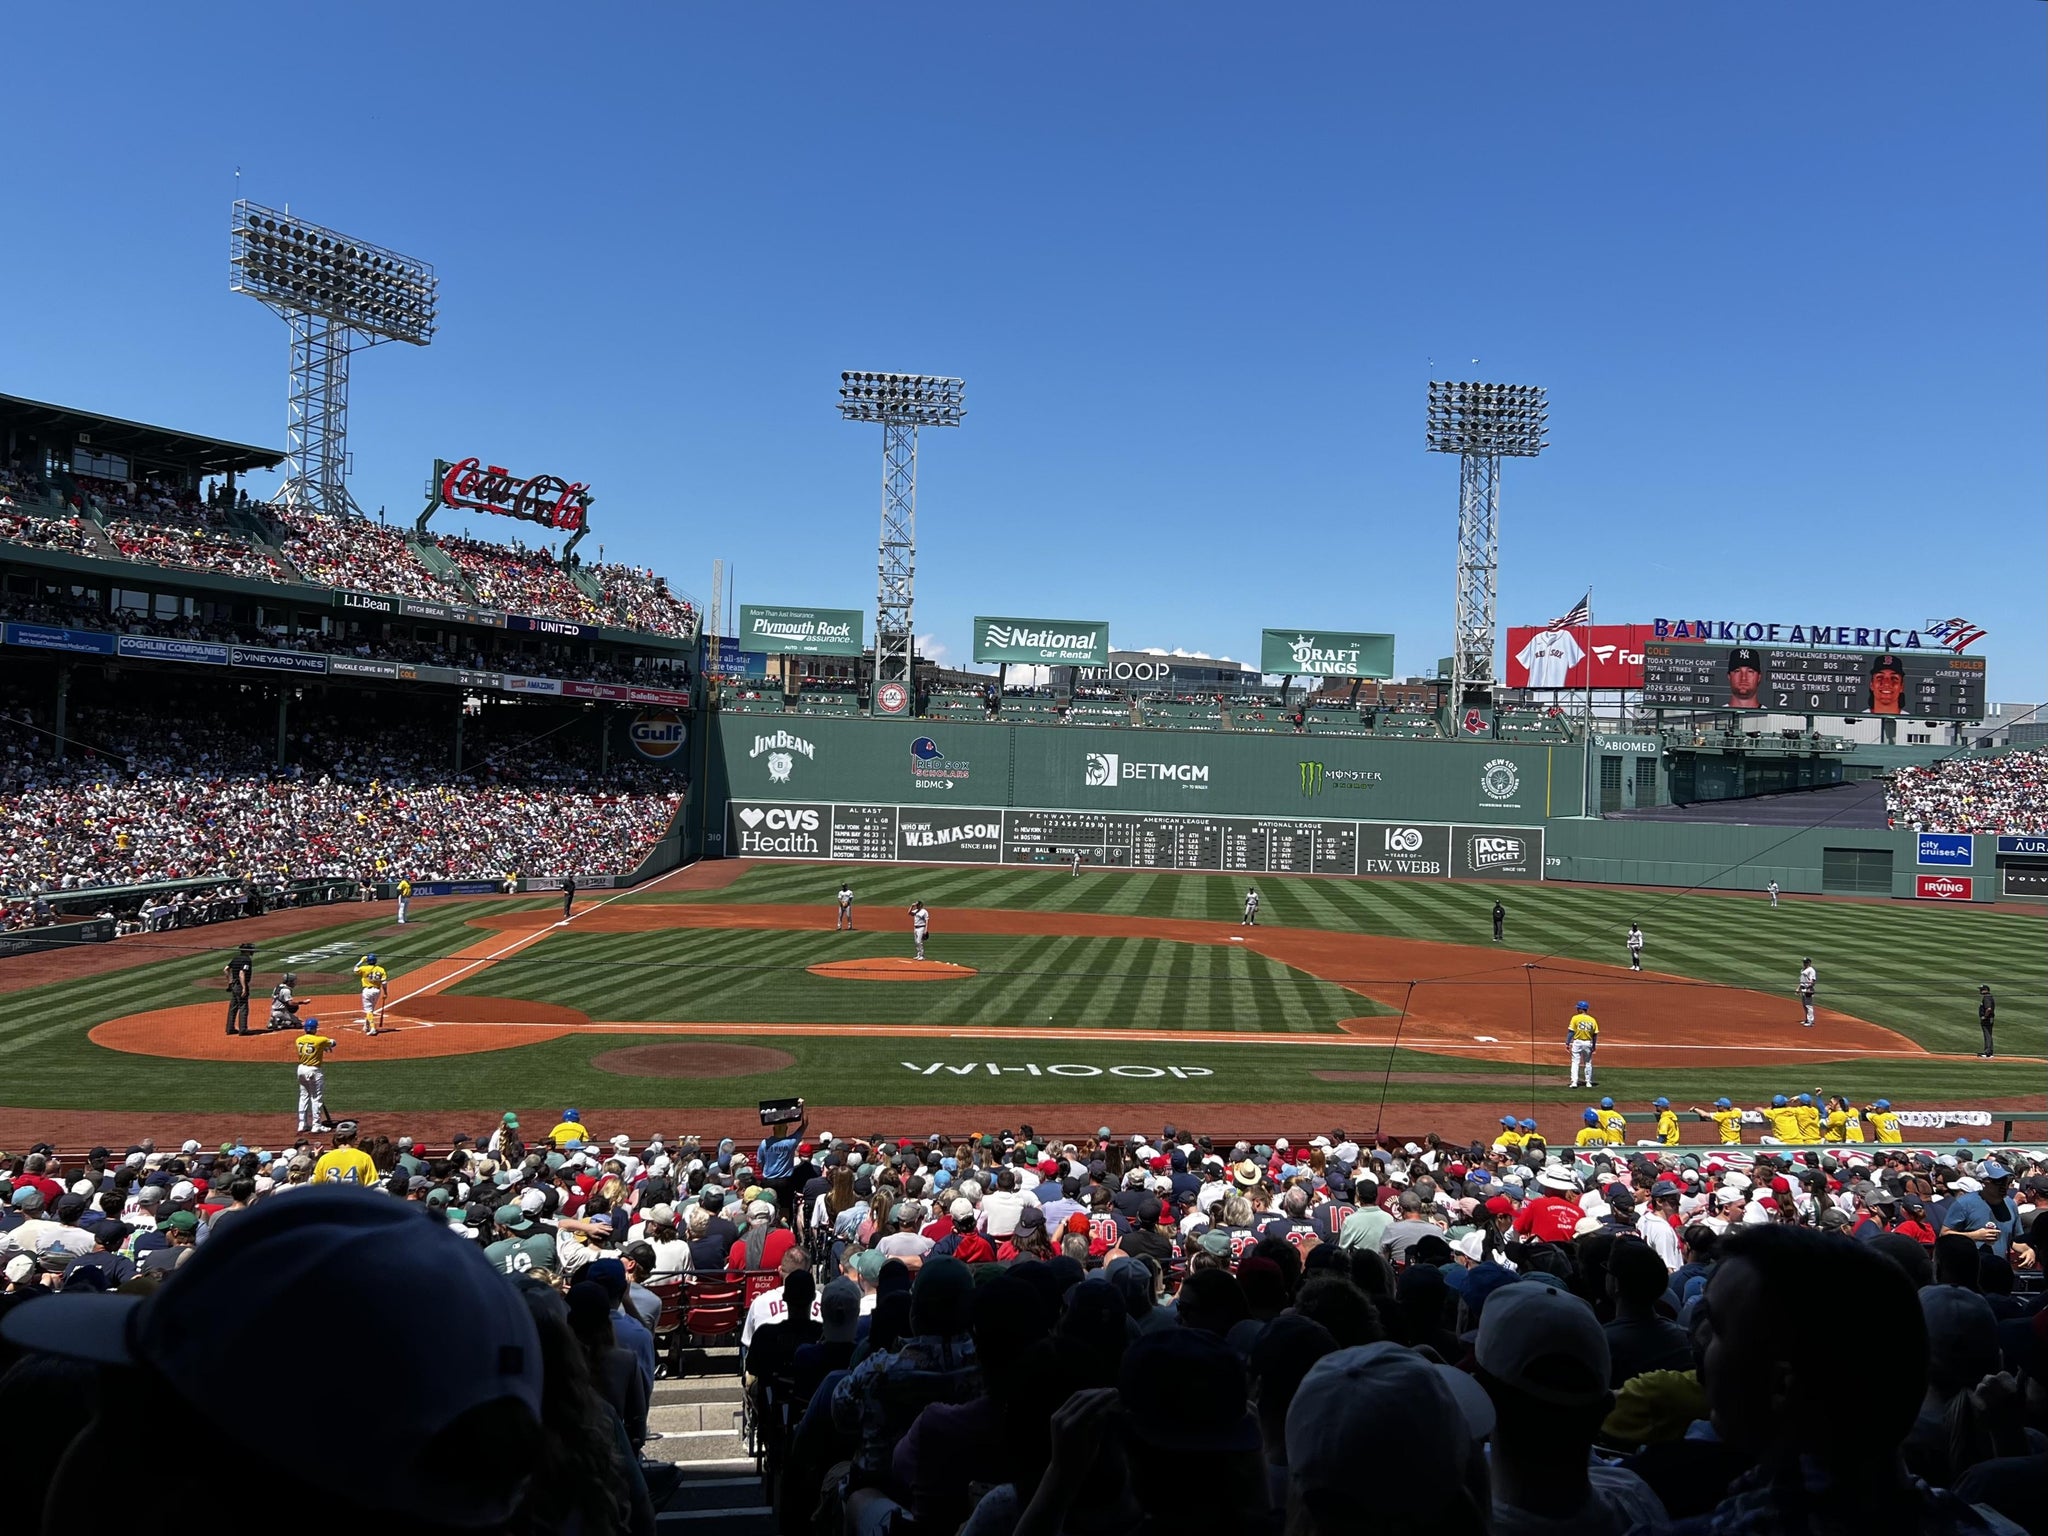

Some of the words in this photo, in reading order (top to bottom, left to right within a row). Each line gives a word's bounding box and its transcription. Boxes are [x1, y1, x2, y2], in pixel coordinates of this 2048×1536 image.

[443, 457, 590, 531] Coca-Cola
[344, 595, 390, 611] L.L.Bean
[407, 605, 424, 613] PITCH
[426, 607, 444, 616] BREAK
[541, 622, 579, 635] UNITED
[753, 619, 814, 634] Plymouth
[817, 622, 850, 636] Rock
[1654, 618, 1735, 640] BANK
[1744, 622, 1780, 642] OF
[1789, 625, 1921, 648] AMERICA
[121, 639, 166, 651] COGHLIN
[168, 644, 226, 656] COMPANIES
[1550, 649, 1564, 659] SOX
[243, 654, 294, 664] VINEYARD
[295, 658, 323, 668] VINES
[724, 655, 750, 663] all-star
[1040, 650, 1057, 658] Car
[1060, 650, 1091, 659] Rental
[1293, 648, 1360, 663] DRAFT
[1079, 663, 1170, 680] WHOOP
[1300, 662, 1358, 675] KINGS
[1949, 661, 1983, 669] SEIGLER
[1771, 673, 1805, 681] KNUCKLE
[1808, 674, 1832, 682] CURVE
[527, 681, 554, 690] AMAZING
[576, 686, 594, 695] Ninety
[630, 691, 659, 701] Safelite
[1779, 694, 1787, 706] 2
[1811, 695, 1819, 707] 0
[1844, 696, 1848, 708] 1
[632, 724, 682, 741] Gulf
[750, 735, 778, 758] JIM
[777, 730, 815, 760] BEAM
[1604, 742, 1656, 752] ABIOMED
[917, 760, 941, 769] RED
[945, 761, 969, 770] SOX
[1483, 759, 1504, 771] IBEW
[1505, 761, 1518, 772] 103
[916, 769, 969, 778] SCHOLARS
[1122, 763, 1208, 782] BETMGM
[1325, 769, 1383, 781] MONSTER
[916, 780, 943, 788] BIDMC
[766, 809, 819, 830] CVS
[741, 831, 818, 852] Health
[1385, 828, 1422, 851] 160
[1479, 838, 1520, 852] ACE
[1921, 841, 1938, 849] city
[1480, 852, 1520, 864] TICKET
[1367, 859, 1392, 872] F.W.
[1396, 860, 1440, 874] WEBB
[413, 887, 434, 896] ZOLL
[1925, 882, 1964, 892] IRVING
[901, 1062, 1214, 1078] WHOOP
